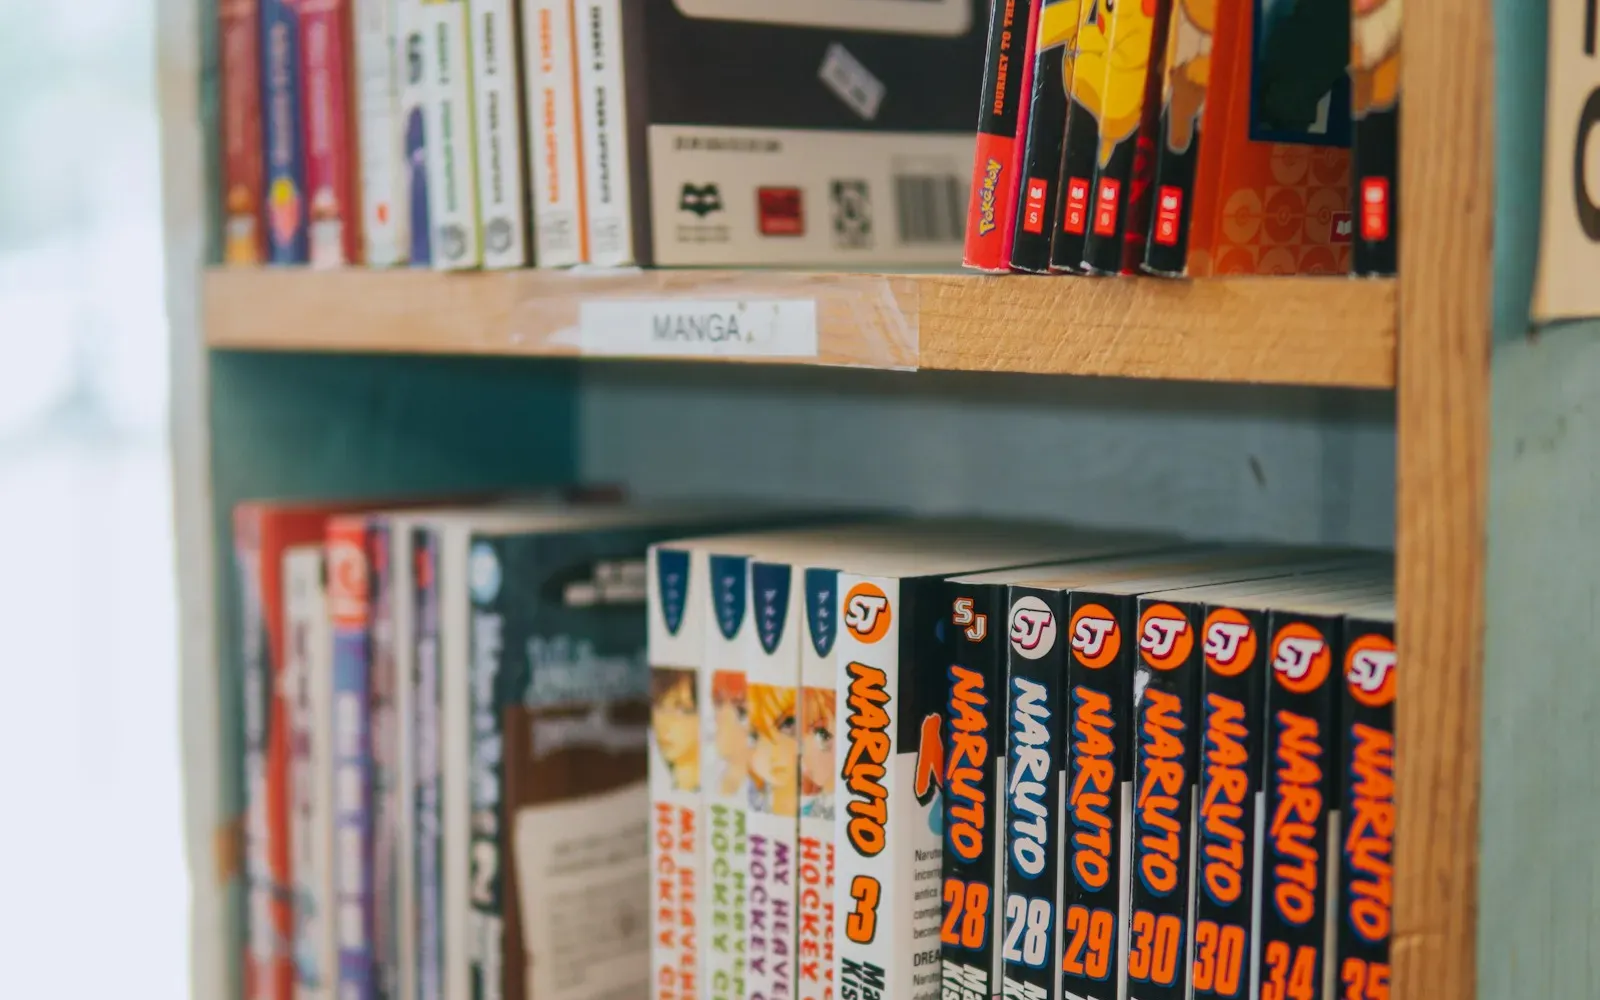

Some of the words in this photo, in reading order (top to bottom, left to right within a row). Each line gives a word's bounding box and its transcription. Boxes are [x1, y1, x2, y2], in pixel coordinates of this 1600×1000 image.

[1001, 31, 1012, 50] TO
[652, 313, 741, 342] MANGA
[952, 597, 988, 643] SJ
[841, 661, 891, 858] NARUTO
[945, 663, 989, 864] NARUTO
[1008, 676, 1052, 880] NARUTO
[1067, 684, 1117, 893] NARUTO
[1136, 687, 1186, 897] NARUTO
[1200, 692, 1250, 906] NARUTO
[773, 839, 789, 886] MY
[1269, 710, 1323, 927] NARUTO
[1345, 723, 1395, 942] NARUTO
[711, 803, 731, 953] HOCKEY
[748, 833, 768, 977] HOCKEY
[799, 835, 821, 983] HOCKEY
[846, 875, 881, 944] 3
[940, 877, 991, 953] 28
[1002, 892, 1054, 969] 28
[1062, 905, 1116, 981] 29
[1128, 909, 1182, 988] 30
[1193, 920, 1246, 998] 30
[1261, 940, 1316, 1000] 34
